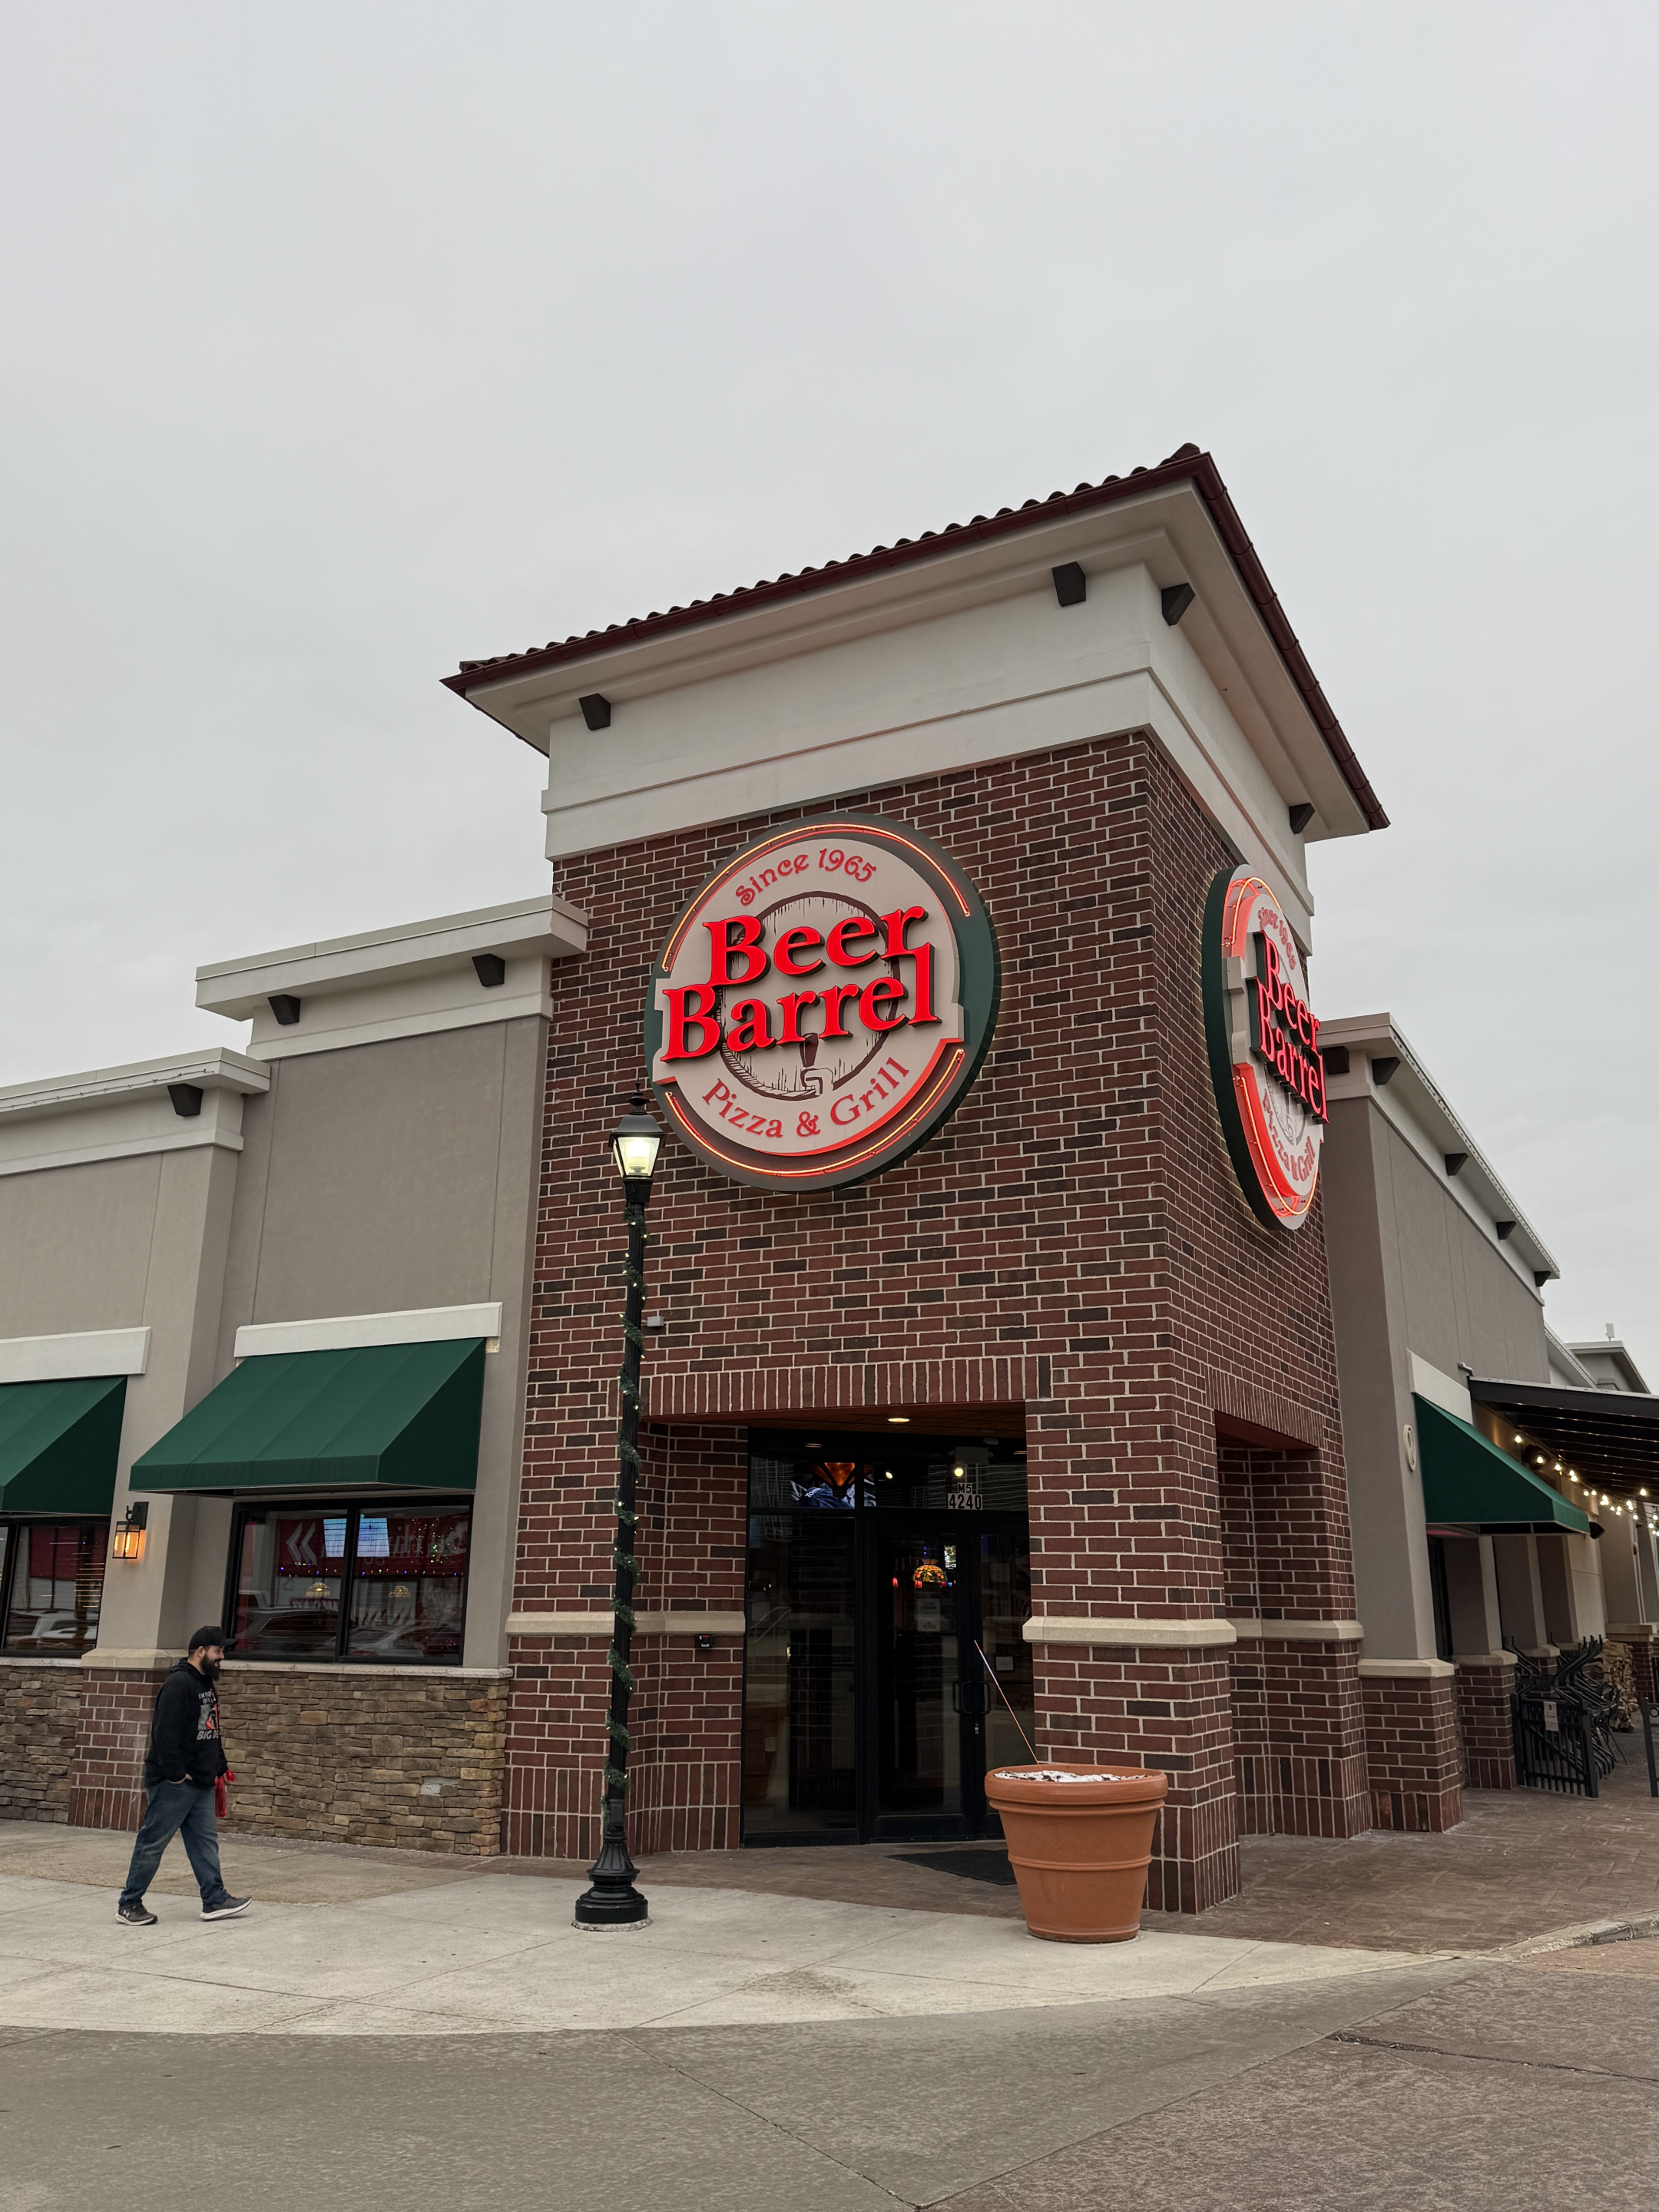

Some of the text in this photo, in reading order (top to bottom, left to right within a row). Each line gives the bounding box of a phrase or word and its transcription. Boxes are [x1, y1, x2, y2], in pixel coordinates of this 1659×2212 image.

[735, 848, 877, 906] Since 1965
[702, 906, 928, 986] Beer
[660, 942, 942, 1063] Barrel
[1260, 929, 1320, 1055] Beer
[1253, 975, 1330, 1124] Barrel
[701, 1056, 910, 1138] Pizza & Grill
[1262, 1089, 1290, 1171] Pizza
[1297, 1135, 1316, 1182] Grill
[949, 1493, 982, 1510] 4240
[197, 1730, 213, 1740] BIG
